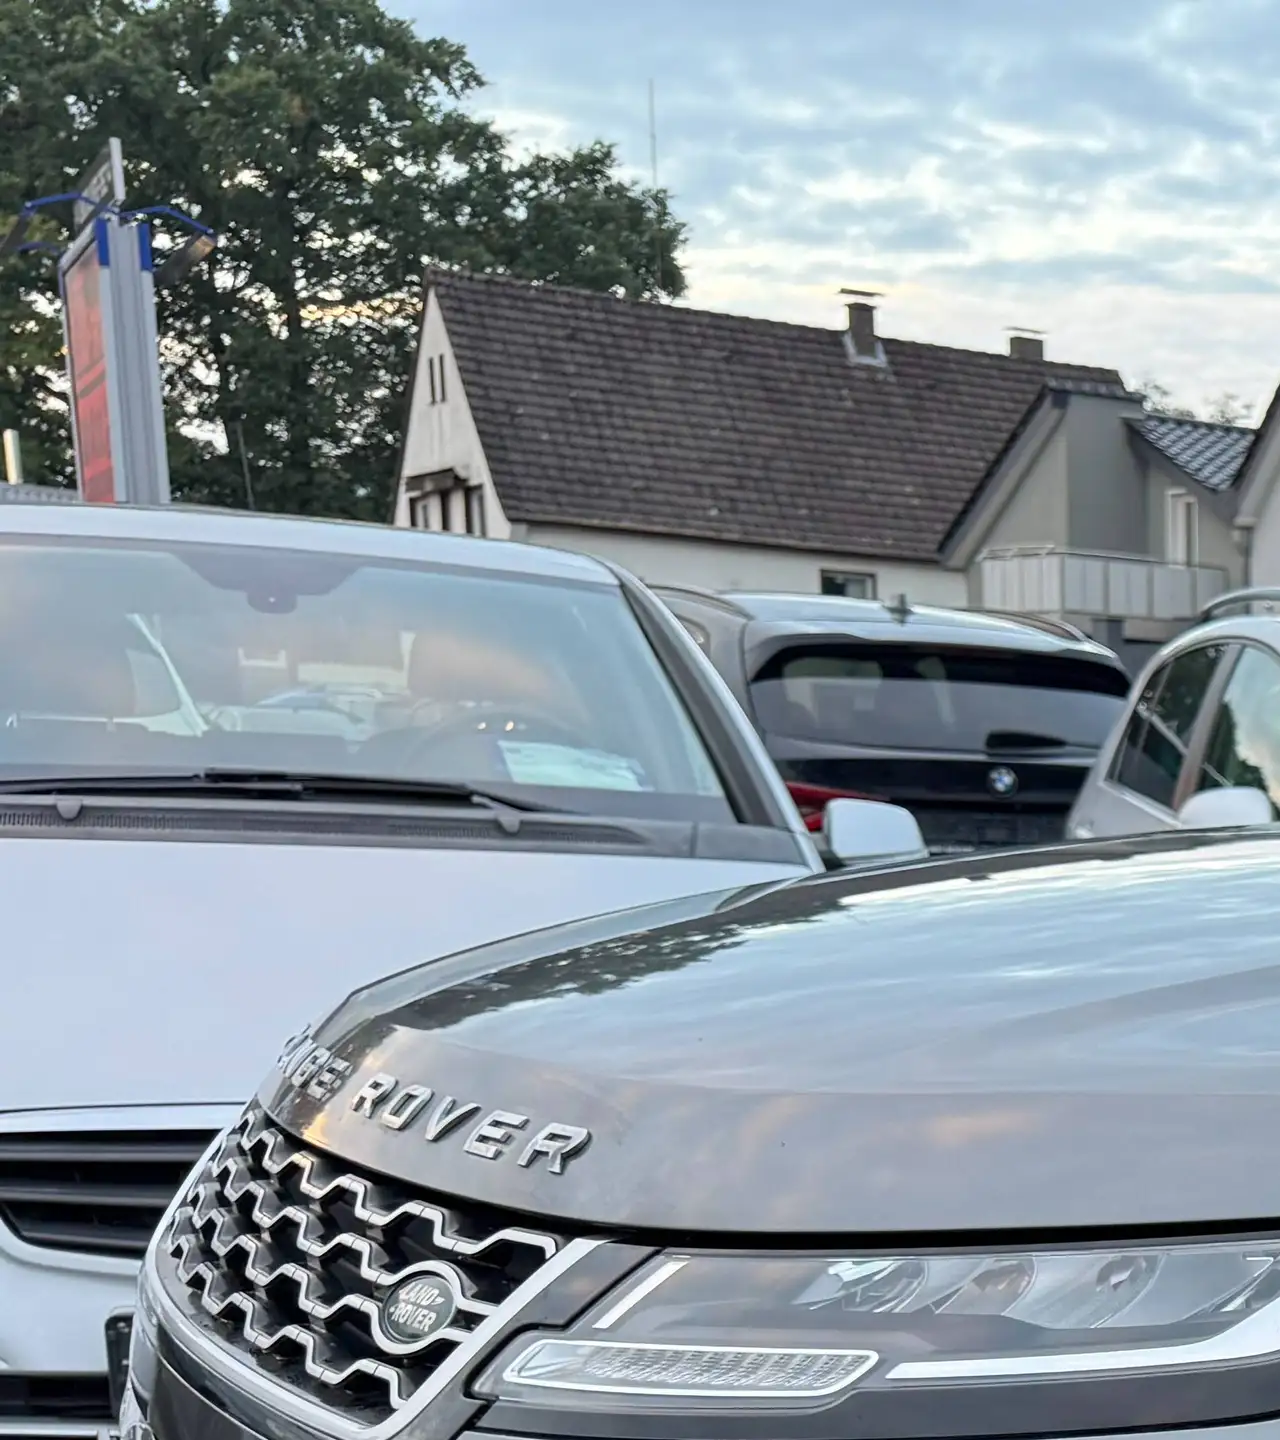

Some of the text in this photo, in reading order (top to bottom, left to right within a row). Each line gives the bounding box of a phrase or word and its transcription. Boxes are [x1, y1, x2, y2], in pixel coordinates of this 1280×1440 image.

[351, 1072, 592, 1174] ROVER
[398, 1282, 440, 1306] LAND
[391, 1302, 437, 1332] ROVER
